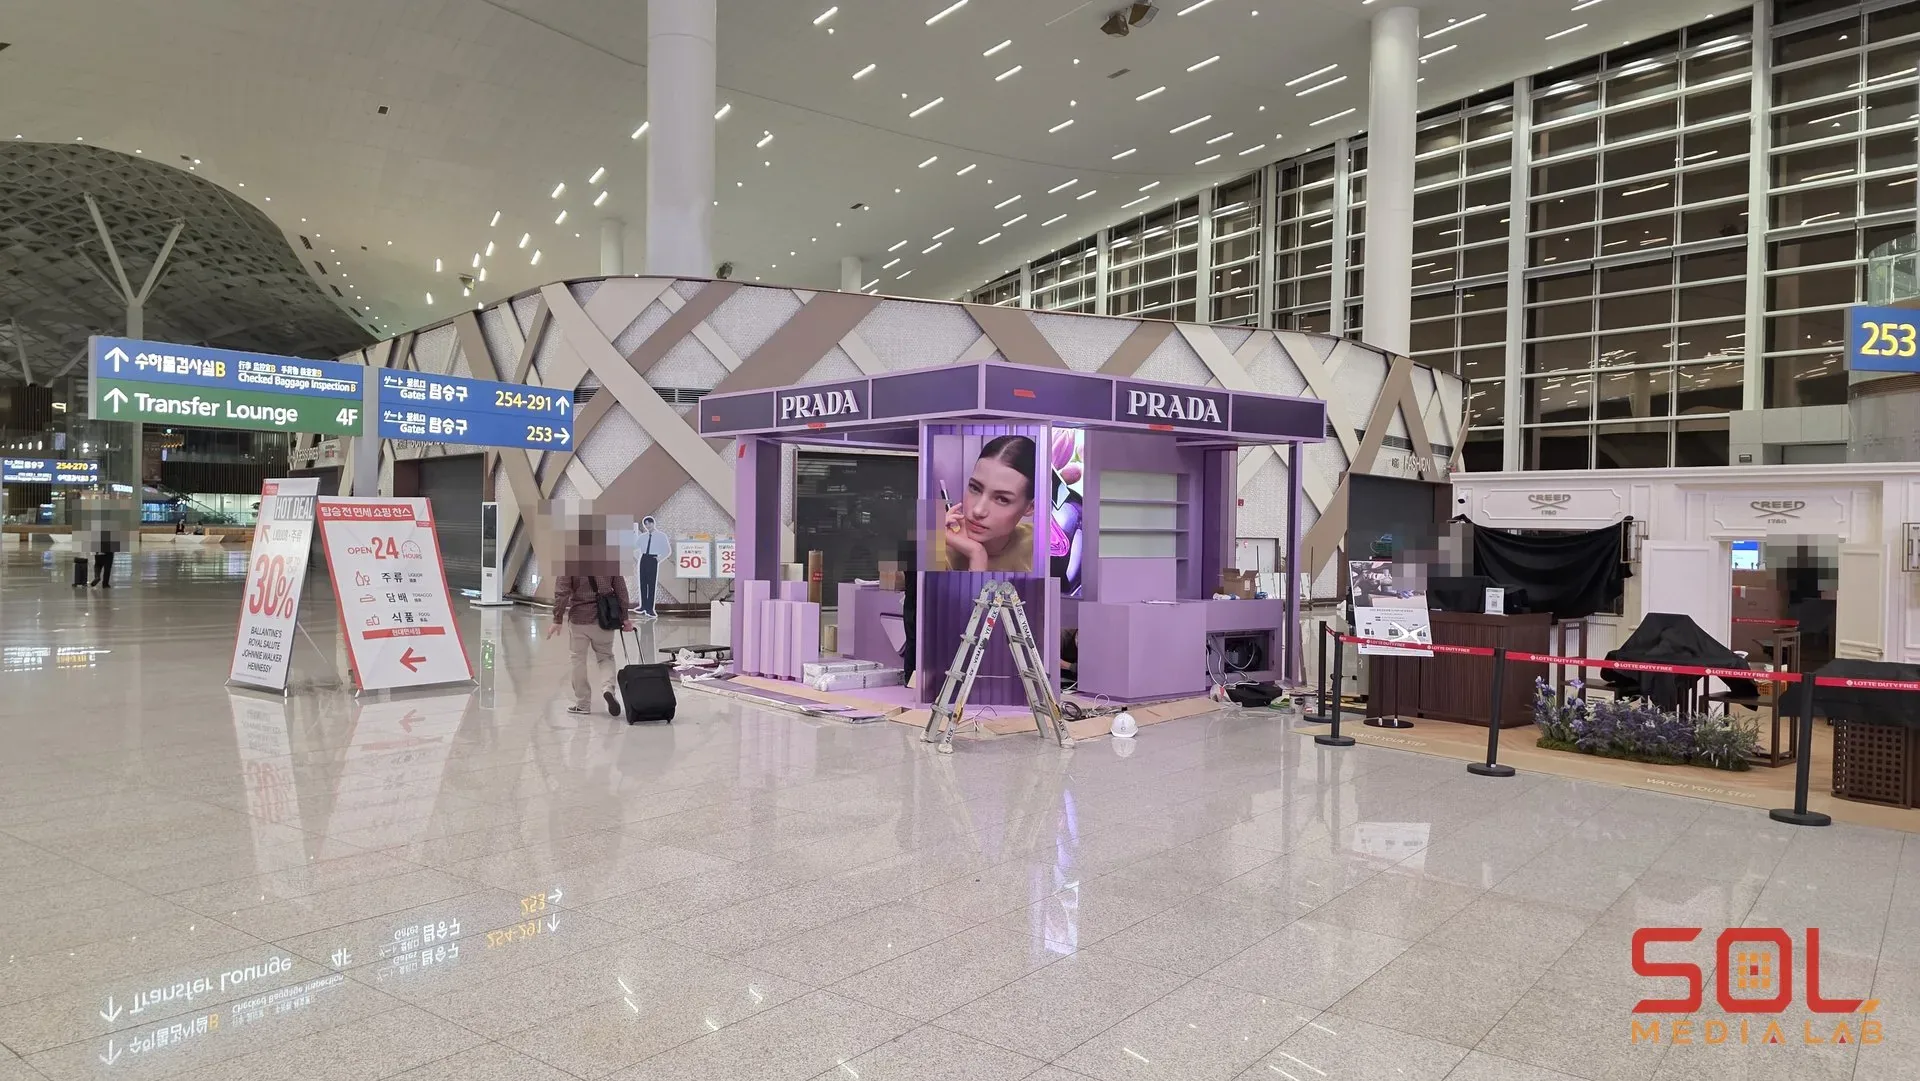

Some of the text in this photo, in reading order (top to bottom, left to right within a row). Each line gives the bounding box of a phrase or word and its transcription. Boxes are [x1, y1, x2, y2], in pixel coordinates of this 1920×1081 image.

[1861, 322, 1916, 357] 253
[135, 352, 226, 378] 수하물검사실B
[238, 372, 356, 392] Checked Baggage Inspection B
[400, 388, 426, 400] Gates
[429, 383, 551, 412] 탑승구 254-291
[133, 392, 358, 427] Transfer Lounge 4F
[781, 389, 860, 420] PRADA
[1127, 390, 1222, 424] PRADA
[400, 422, 426, 434] Gates
[429, 416, 552, 442] 탑승구 253
[1528, 494, 1571, 504] CREED
[1751, 501, 1806, 512] CREED
[274, 496, 314, 520] HOT DEAL
[353, 507, 372, 518] 면세
[373, 508, 391, 518] 쇼핑
[392, 508, 412, 518] 찬스
[348, 546, 372, 555] OPEN
[371, 536, 399, 560] 24
[381, 572, 403, 583] 주류
[249, 554, 294, 618] 30%
[386, 592, 408, 603] 담배
[392, 612, 414, 622] 식품
[250, 626, 282, 638] BALLANTINE'S
[248, 638, 280, 650] ROYAL SALUTE
[242, 649, 282, 662] JOHNNIE WALKER
[247, 662, 272, 673] HENNESSY
[1646, 778, 1756, 798] WATCH YOUR STEP
